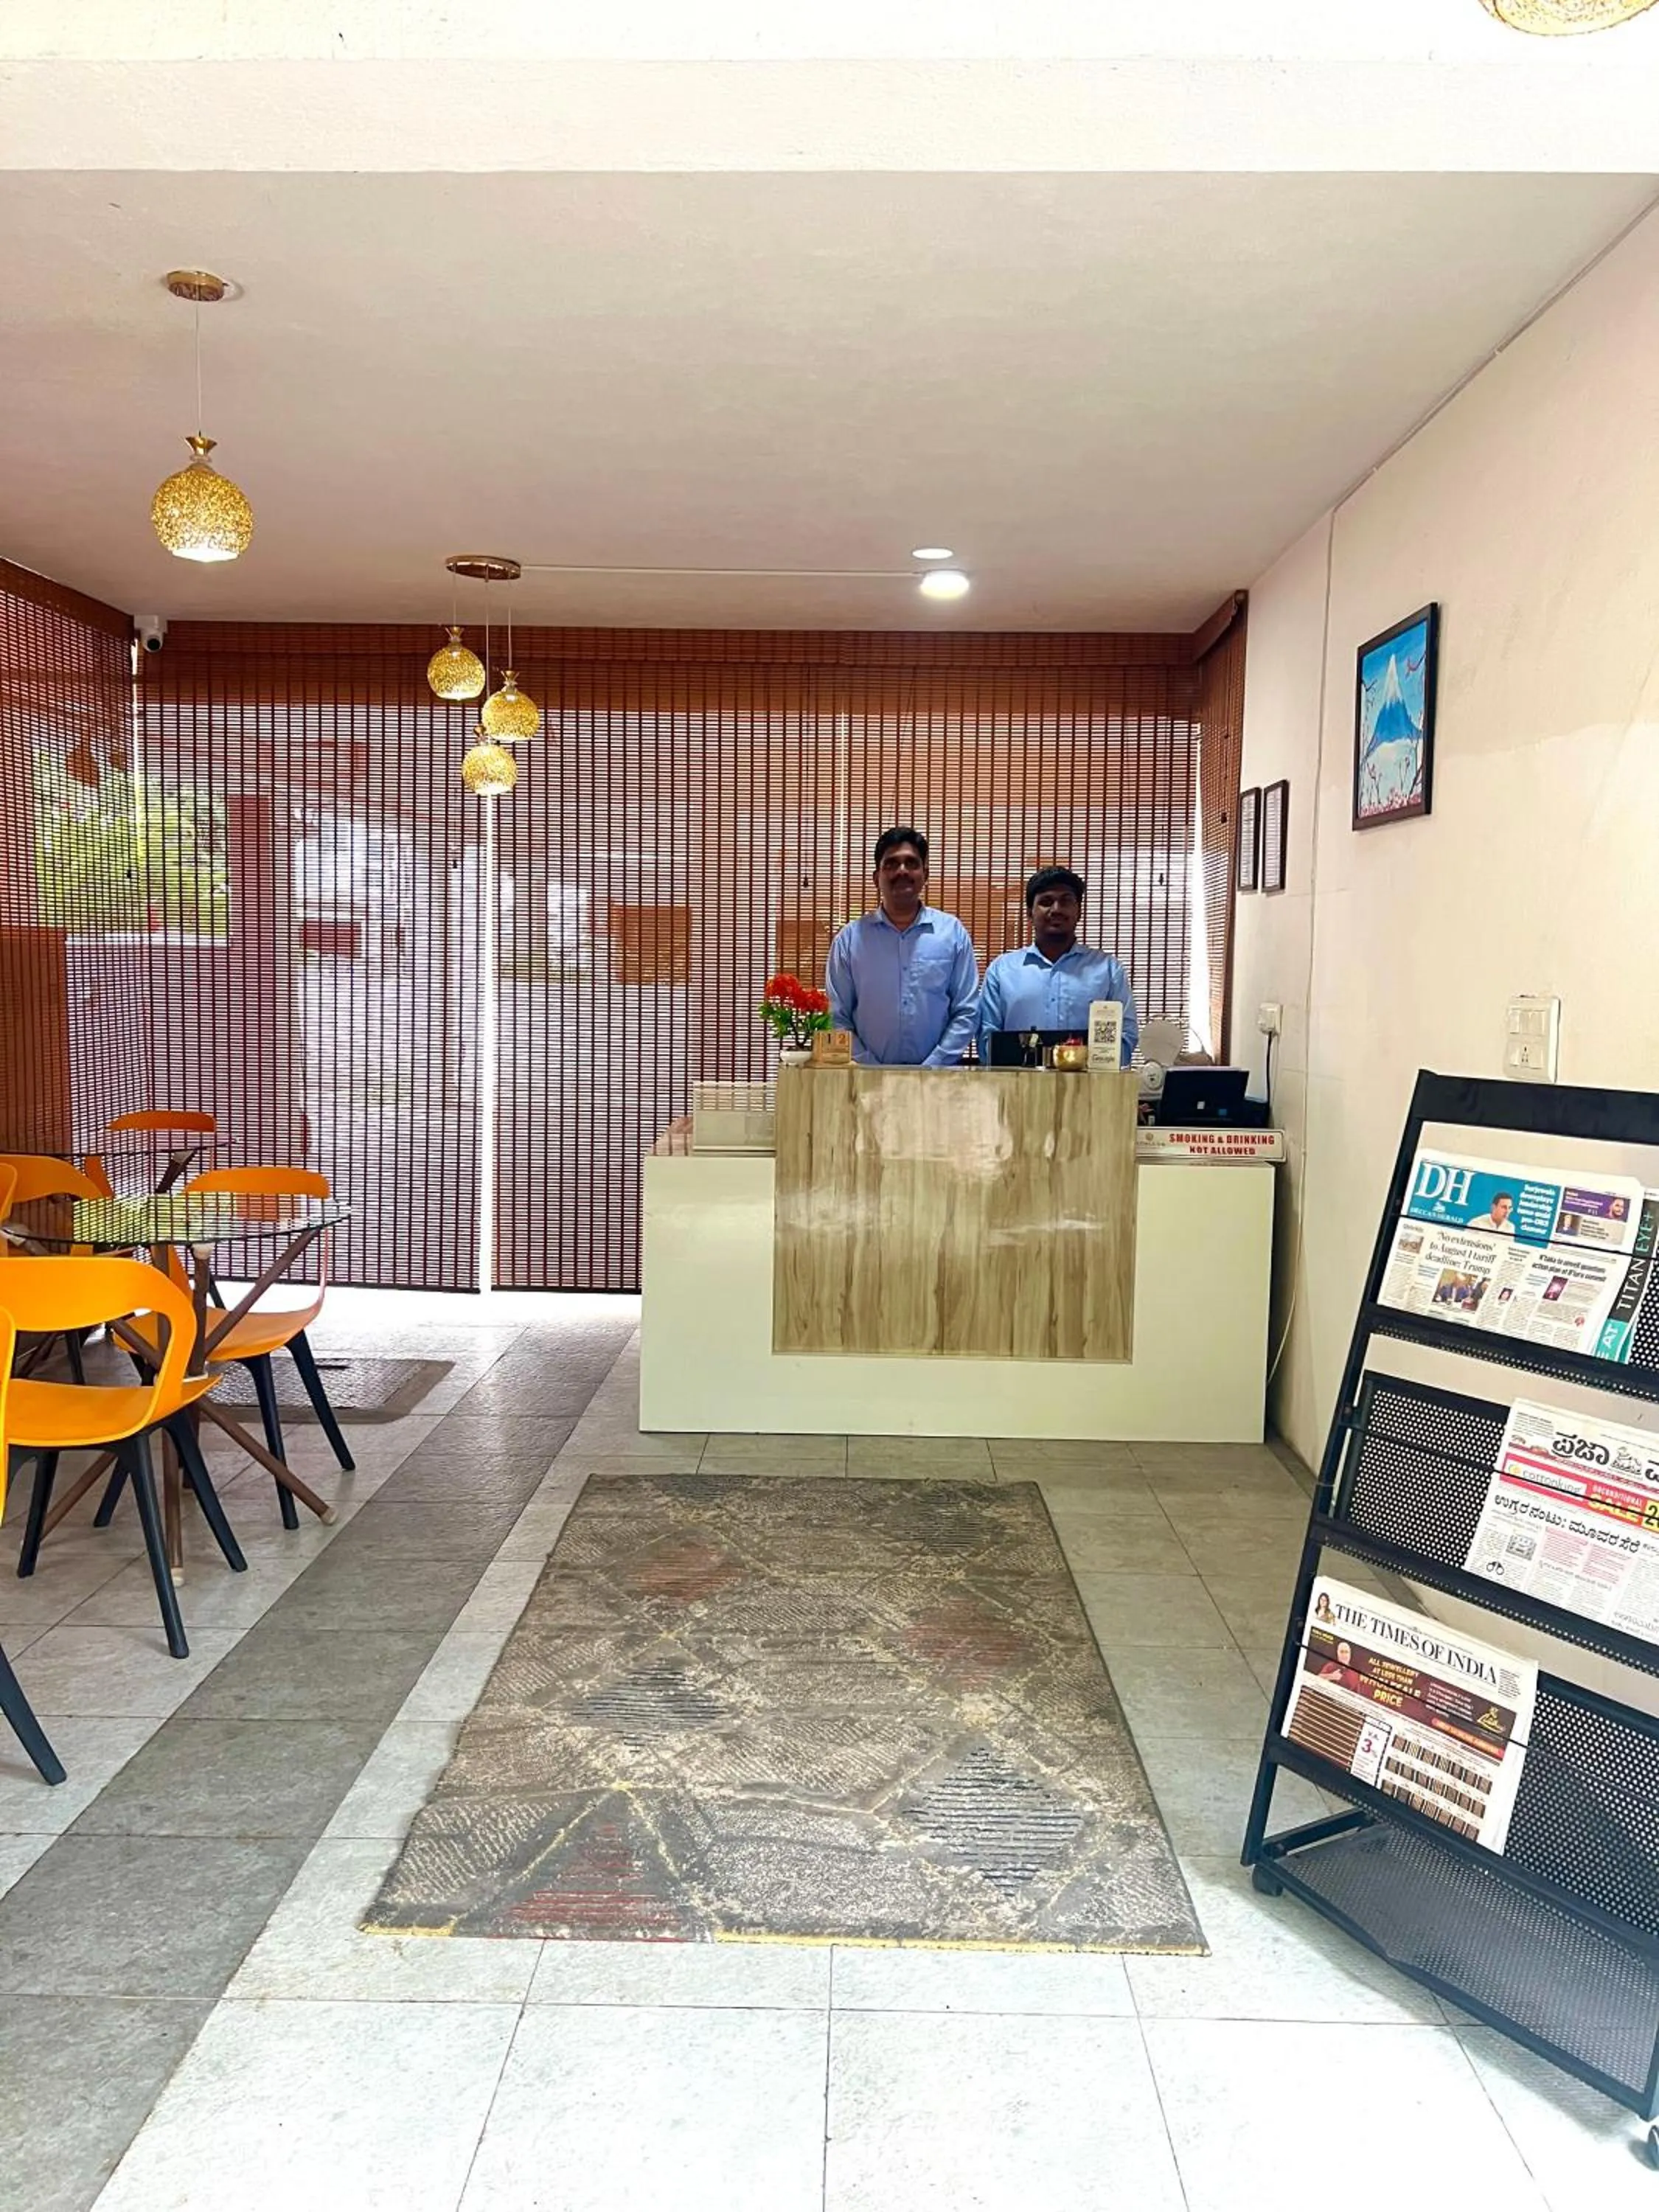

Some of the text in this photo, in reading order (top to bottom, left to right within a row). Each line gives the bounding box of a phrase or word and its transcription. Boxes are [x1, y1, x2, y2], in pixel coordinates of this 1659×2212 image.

[1169, 1133, 1215, 1144] SMOKING
[1217, 1135, 1224, 1144] &
[1226, 1135, 1276, 1145] DRINKING
[1189, 1146, 1256, 1155] NOT ALLOWED
[1413, 1162, 1475, 1206] DH
[1463, 1260, 1491, 1275] Trump
[1616, 1257, 1646, 1310] TITAN
[1335, 1604, 1368, 1628] THE
[1370, 1617, 1419, 1651] TIMES
[1422, 1639, 1445, 1660] OF
[1447, 1647, 1497, 1684] INDIA
[1373, 1688, 1404, 1707] PRICE
